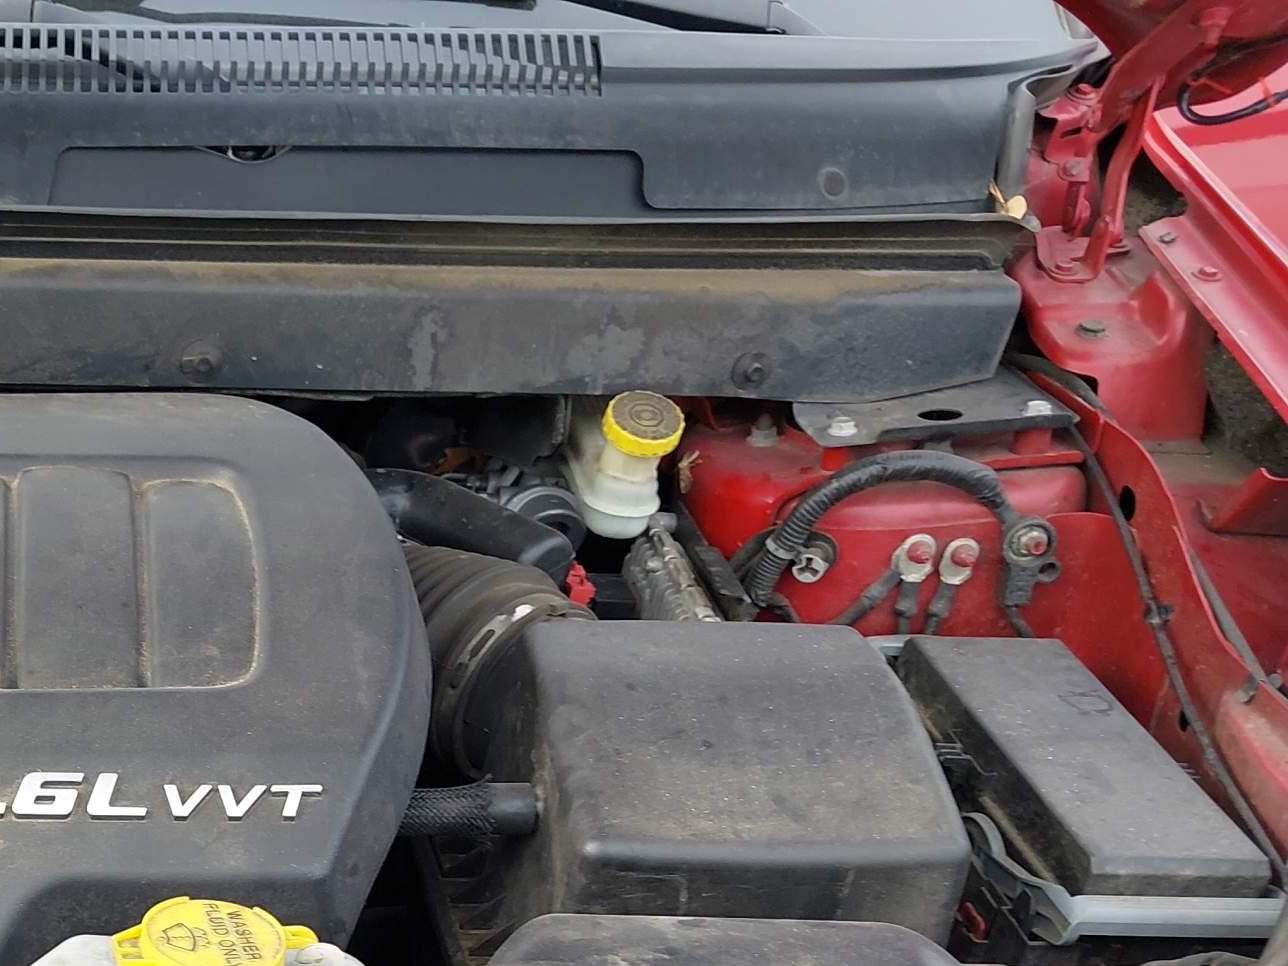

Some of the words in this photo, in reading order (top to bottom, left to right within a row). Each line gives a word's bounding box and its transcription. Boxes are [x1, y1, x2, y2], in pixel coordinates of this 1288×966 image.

[162, 783, 325, 822] VVT
[202, 903, 229, 936] FLUID
[226, 910, 263, 960] WASHER
